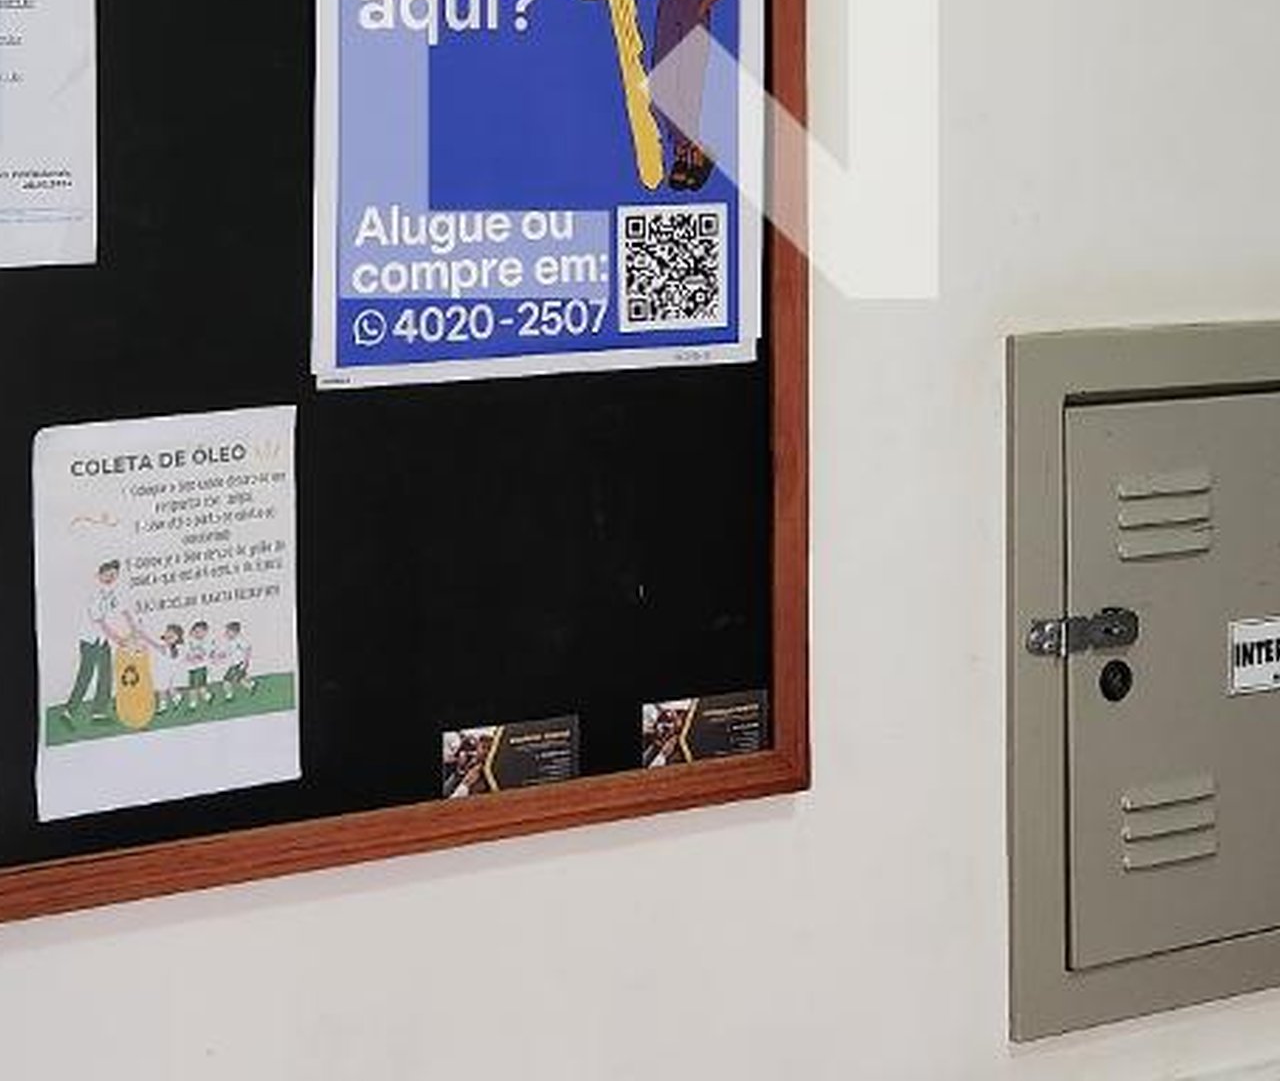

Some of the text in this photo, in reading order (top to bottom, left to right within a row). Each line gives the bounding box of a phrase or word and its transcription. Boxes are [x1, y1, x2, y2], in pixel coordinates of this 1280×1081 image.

[354, 204, 573, 255] Alugue ou
[352, 254, 610, 298] compre em:
[70, 443, 246, 476] COLETA DE ÓLEO
